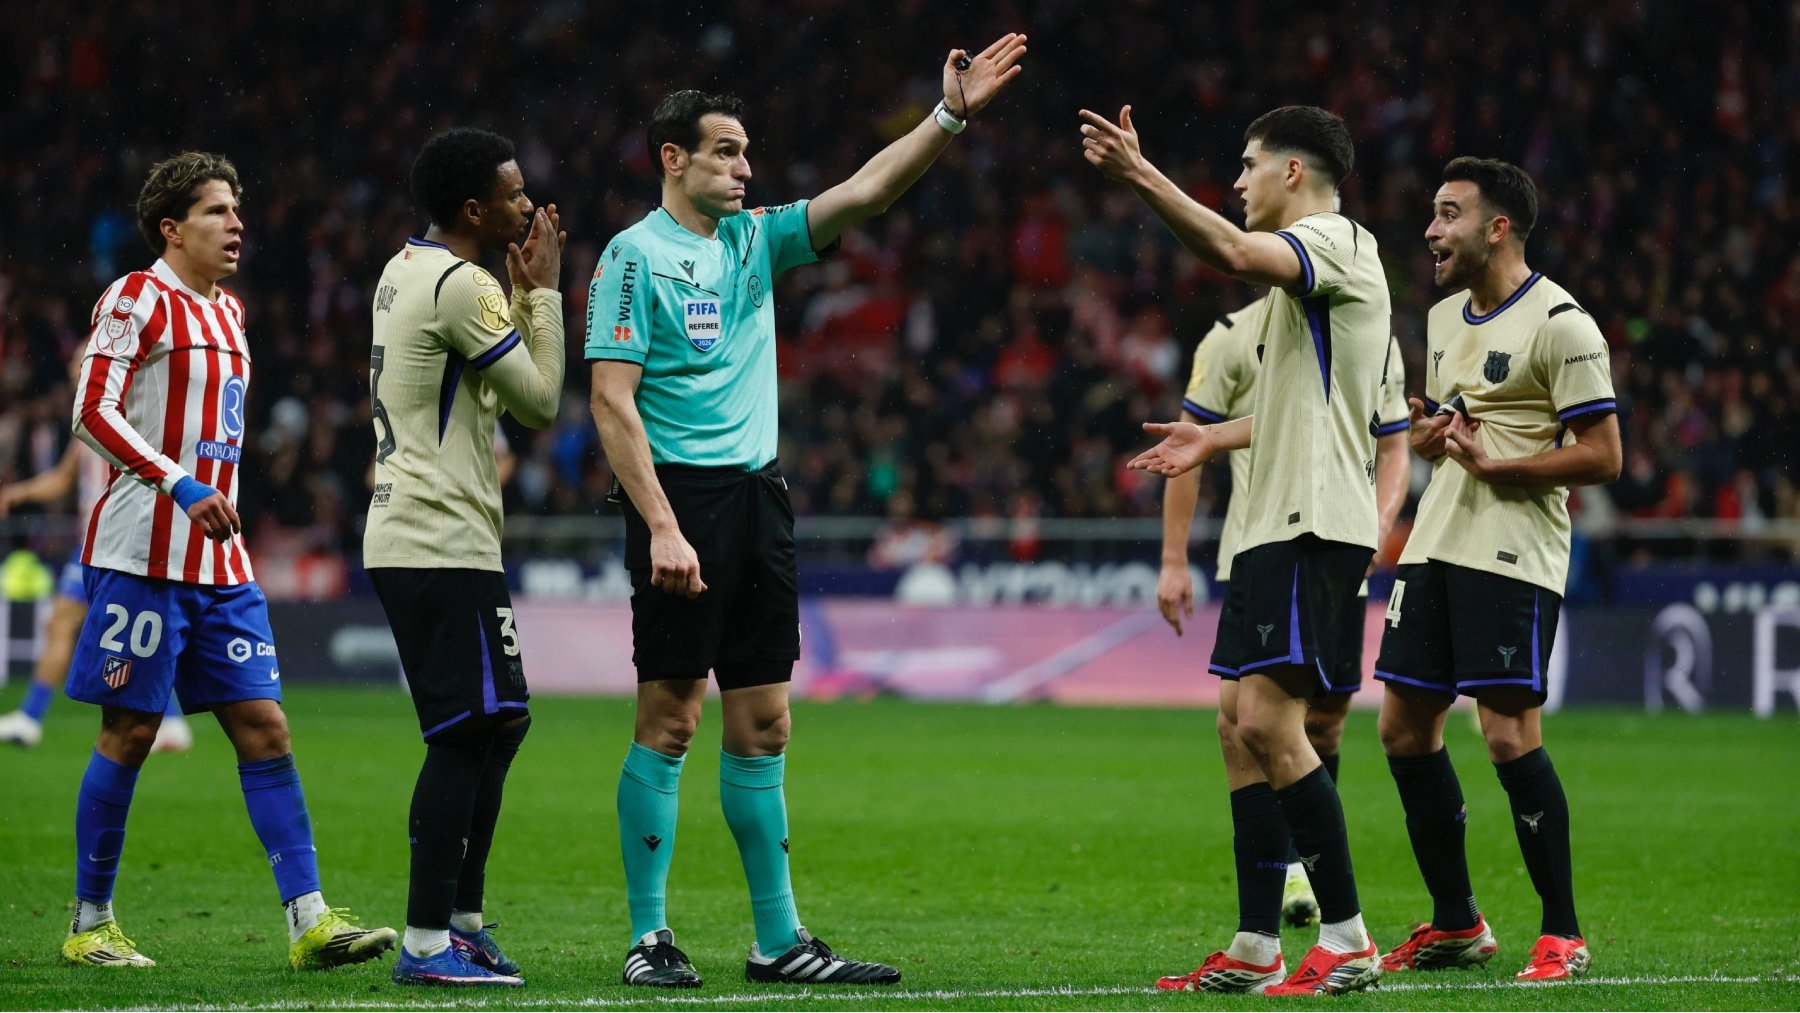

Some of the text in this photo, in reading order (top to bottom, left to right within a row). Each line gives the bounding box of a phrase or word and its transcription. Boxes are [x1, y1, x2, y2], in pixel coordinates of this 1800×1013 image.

[618, 261, 637, 321] WÜRTH
[688, 303, 717, 315] FIFA
[200, 442, 240, 462] RIYADH
[1385, 579, 1406, 628] 4
[99, 603, 163, 658] 20
[496, 607, 520, 657] 3
